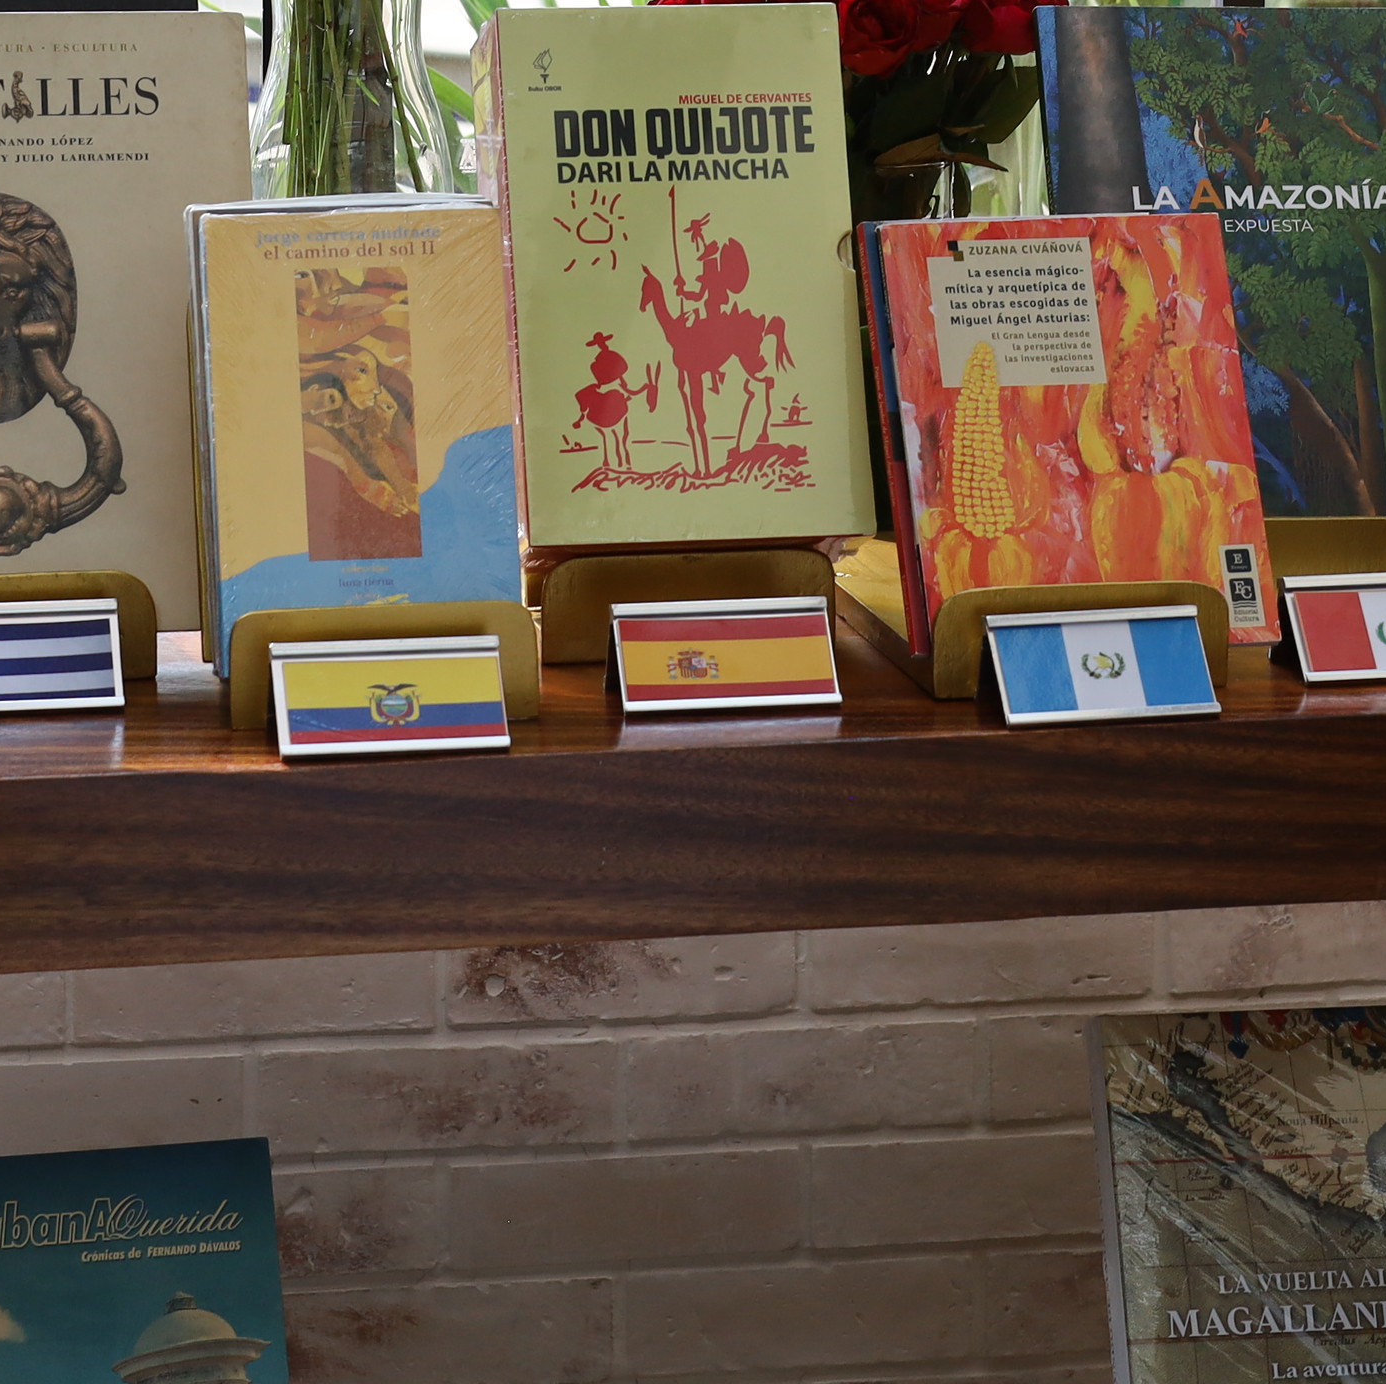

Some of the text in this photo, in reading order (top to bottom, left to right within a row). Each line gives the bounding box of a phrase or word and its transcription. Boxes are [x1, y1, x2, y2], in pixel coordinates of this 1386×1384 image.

[53, 42, 139, 53] ESCULTURA
[678, 92, 812, 105] MIGUEL DE CERVANTES
[554, 105, 815, 159] DON QUIJOTE
[51, 134, 94, 147] LÓPEZ
[1, 153, 9, 163] Y
[15, 153, 55, 163] JULIO
[61, 152, 150, 162] LARRAMENDI
[557, 158, 789, 184] DARI LA MANCHA
[1131, 184, 1180, 211] LA
[1224, 218, 1314, 233] EXPUESTA
[254, 225, 441, 247] jorge carrera andrade
[264, 240, 435, 260] el camino del sol II
[968, 245, 1017, 255] ZUZANA
[967, 265, 1084, 280] La esencia mágico-
[944, 280, 1086, 296] mítica y arquetípica de
[950, 296, 1088, 310] las obras escogidas de
[950, 312, 1091, 328] Miguel Ángel Asturias:
[991, 330, 1090, 341] El Gran Lengua desde
[1012, 341, 1092, 352] la perspectiva de
[1005, 353, 1093, 363] las investigaciones
[1050, 365, 1095, 373] eslovacas
[1232, 553, 1243, 564] E
[81, 1239, 241, 1263] Crónicas de FERNANDO DÁVALOS
[1217, 1273, 1251, 1296] LA
[1257, 1270, 1355, 1293] VUELTA
[1271, 1359, 1298, 1380] La
